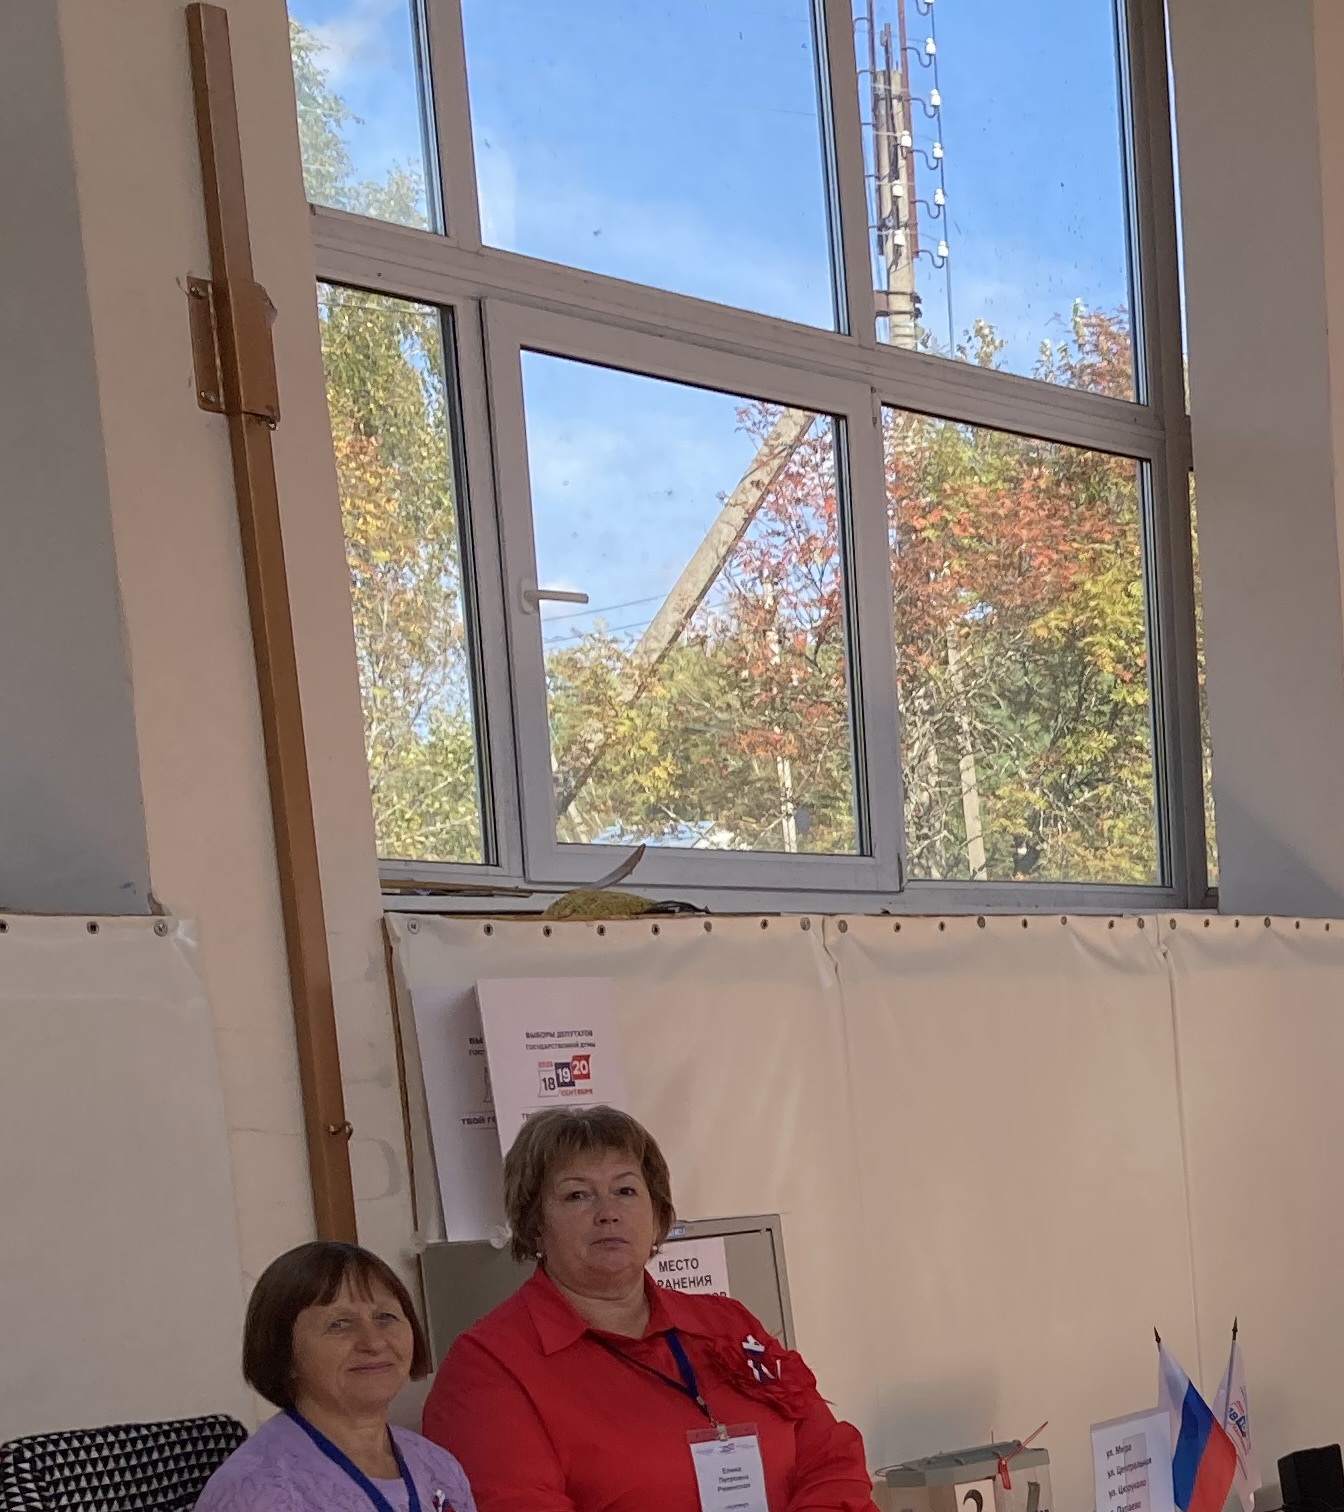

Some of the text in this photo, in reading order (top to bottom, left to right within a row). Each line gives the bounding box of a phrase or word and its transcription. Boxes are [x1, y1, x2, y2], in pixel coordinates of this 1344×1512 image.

[557, 1067, 571, 1083] 19
[572, 1060, 589, 1075] 20
[542, 1077, 556, 1091] 18
[659, 1257, 699, 1272] МЕСТО
[657, 1275, 712, 1289] РАНЕНИЯ
